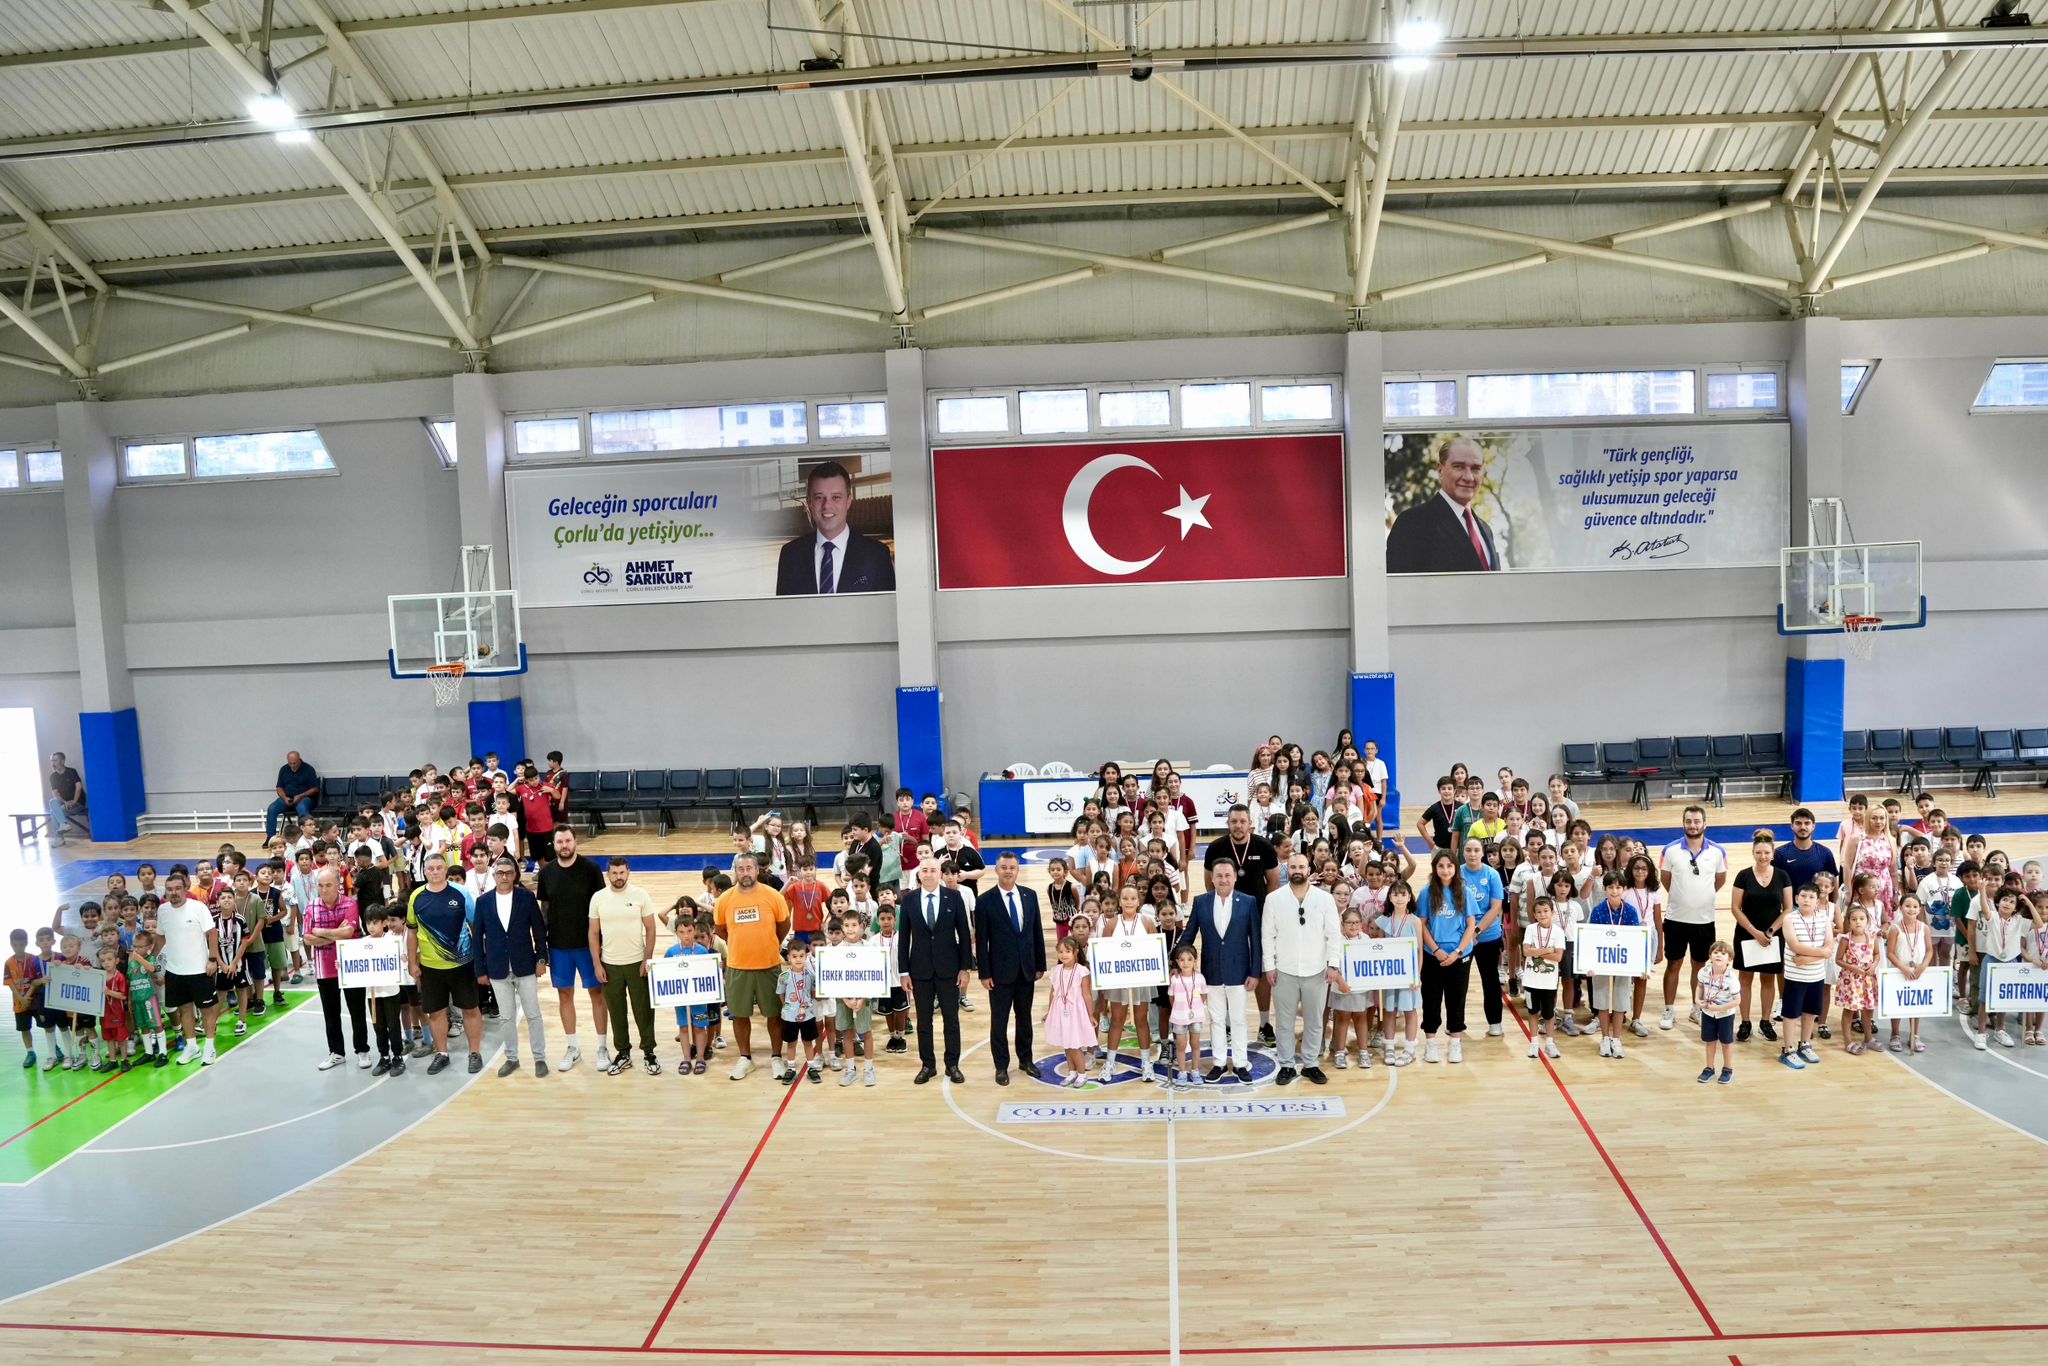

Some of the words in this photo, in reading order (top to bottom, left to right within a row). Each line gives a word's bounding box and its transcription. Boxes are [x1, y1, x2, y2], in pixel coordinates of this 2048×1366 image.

[1603, 448, 1637, 462] "Türk
[1641, 446, 1694, 464] gençliği,
[1558, 469, 1605, 487] sağlıklı
[1607, 469, 1650, 487] yetişip
[1654, 470, 1683, 486] spor
[1684, 470, 1738, 486] yaparsa
[548, 494, 627, 518] Geleceğin
[632, 491, 718, 516] sporcuları
[1582, 491, 1659, 505] ulusumuzun
[1663, 488, 1716, 506] geleceği
[1584, 512, 1637, 530] güvence
[1640, 509, 1714, 526] altındadır."
[627, 520, 714, 545] yetişiyor...
[625, 560, 674, 573] AHMET
[625, 572, 692, 586] SARIKURT
[1596, 944, 1628, 964] TENİS
[344, 959, 369, 973] MASA
[371, 954, 397, 972] TENİSİ
[1098, 961, 1112, 974] KIZ
[1114, 958, 1160, 973] BASKETBOL
[1353, 959, 1406, 977] VOLEYBOL
[822, 970, 843, 981] ERKEK
[845, 970, 884, 981] BASKETBOL
[61, 983, 91, 1002] FUTBOL
[657, 978, 689, 996] MUAY
[692, 976, 716, 993] THAI
[1999, 983, 2048, 1003] SATRANÇ
[1896, 986, 1933, 1006] YÜZME
[1012, 1107, 1123, 1118] ÇORLU
